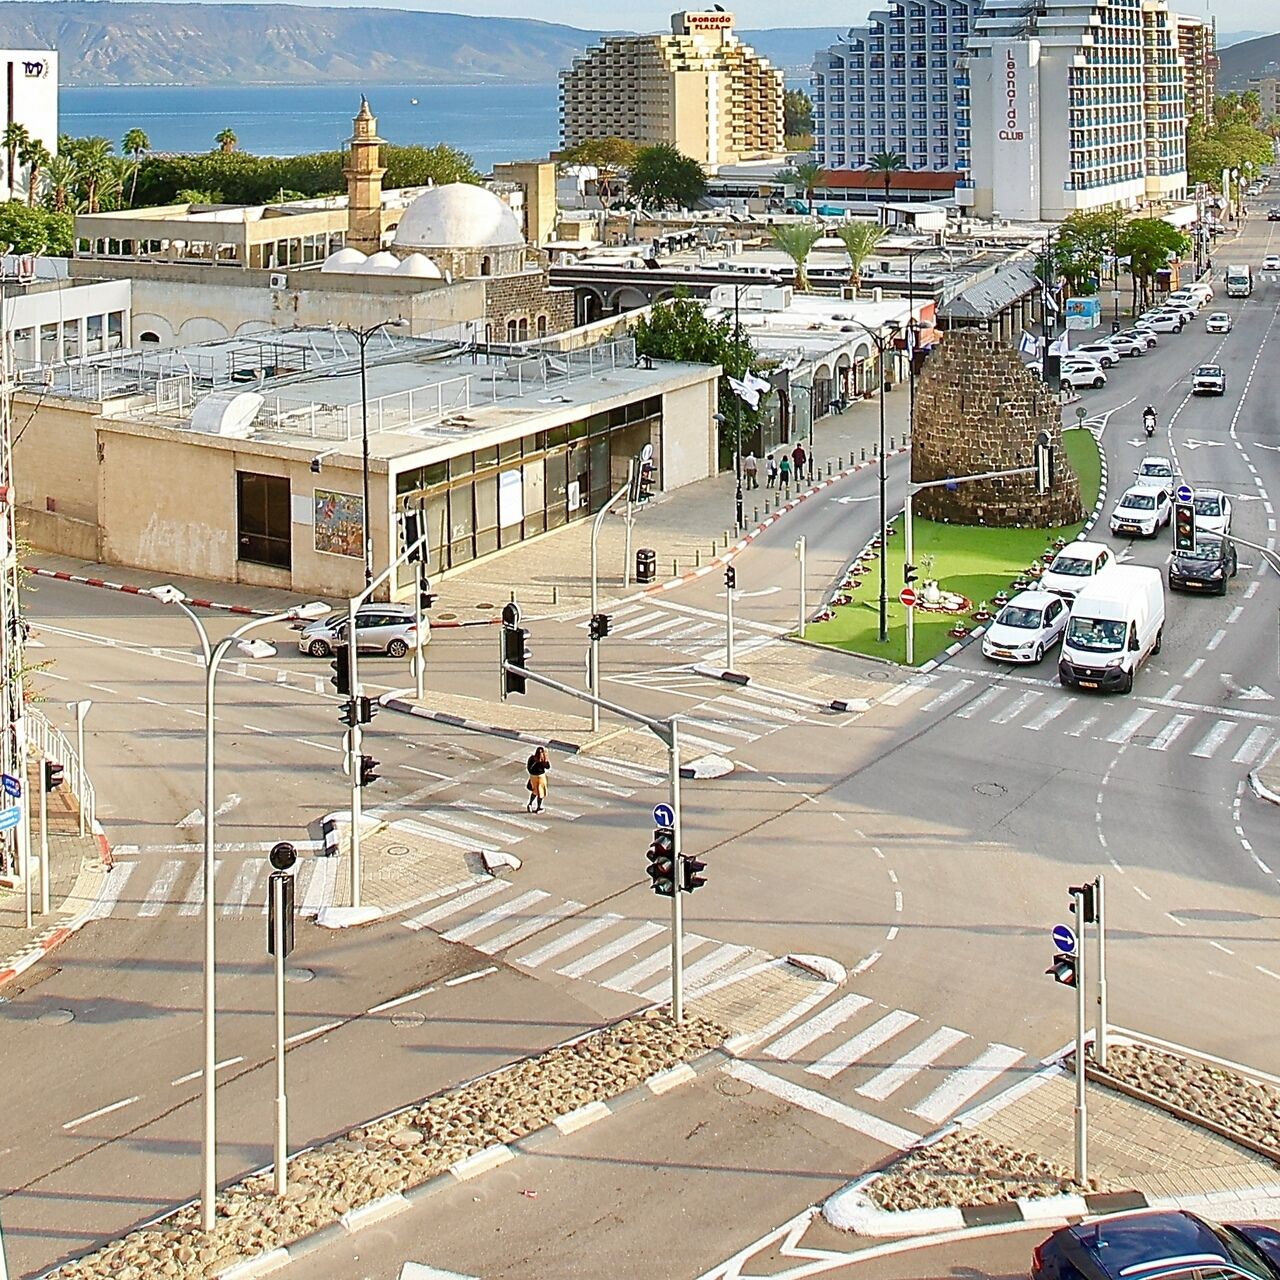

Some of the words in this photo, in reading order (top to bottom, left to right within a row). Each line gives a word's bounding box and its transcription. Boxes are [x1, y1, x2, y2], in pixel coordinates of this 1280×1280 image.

[687, 15, 731, 23] Leonardo
[1007, 49, 1016, 129] Leonardo
[999, 130, 1024, 141] CLUB
